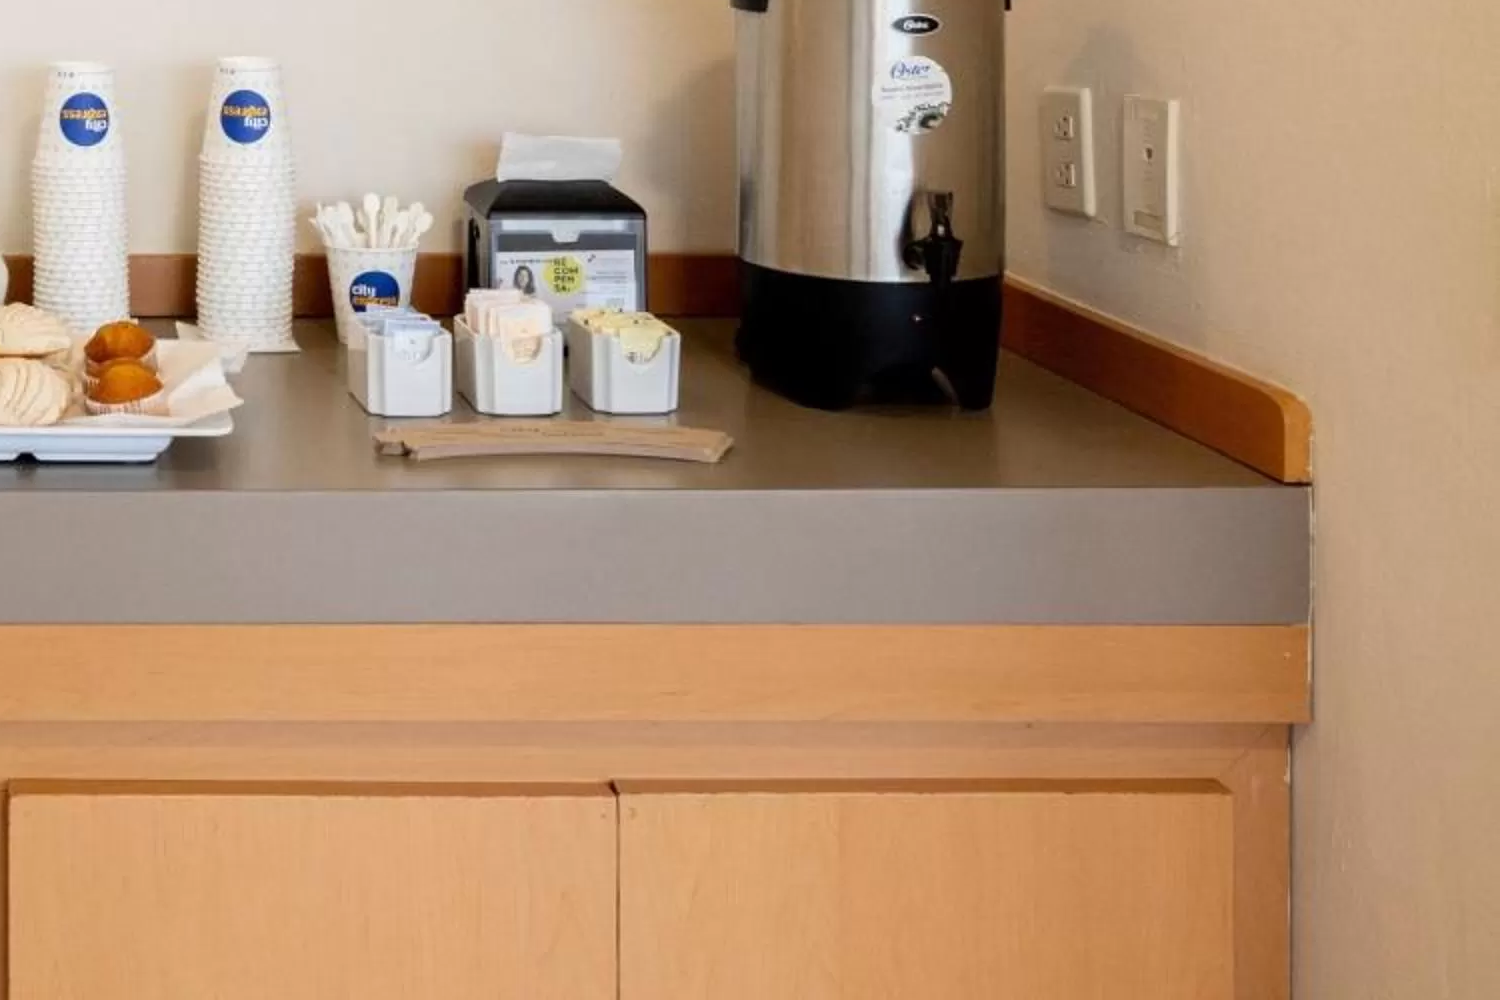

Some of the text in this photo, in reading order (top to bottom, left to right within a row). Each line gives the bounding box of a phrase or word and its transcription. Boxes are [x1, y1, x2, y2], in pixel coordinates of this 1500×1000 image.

[84, 118, 107, 132] city
[243, 116, 269, 130] city
[350, 283, 377, 297] city
